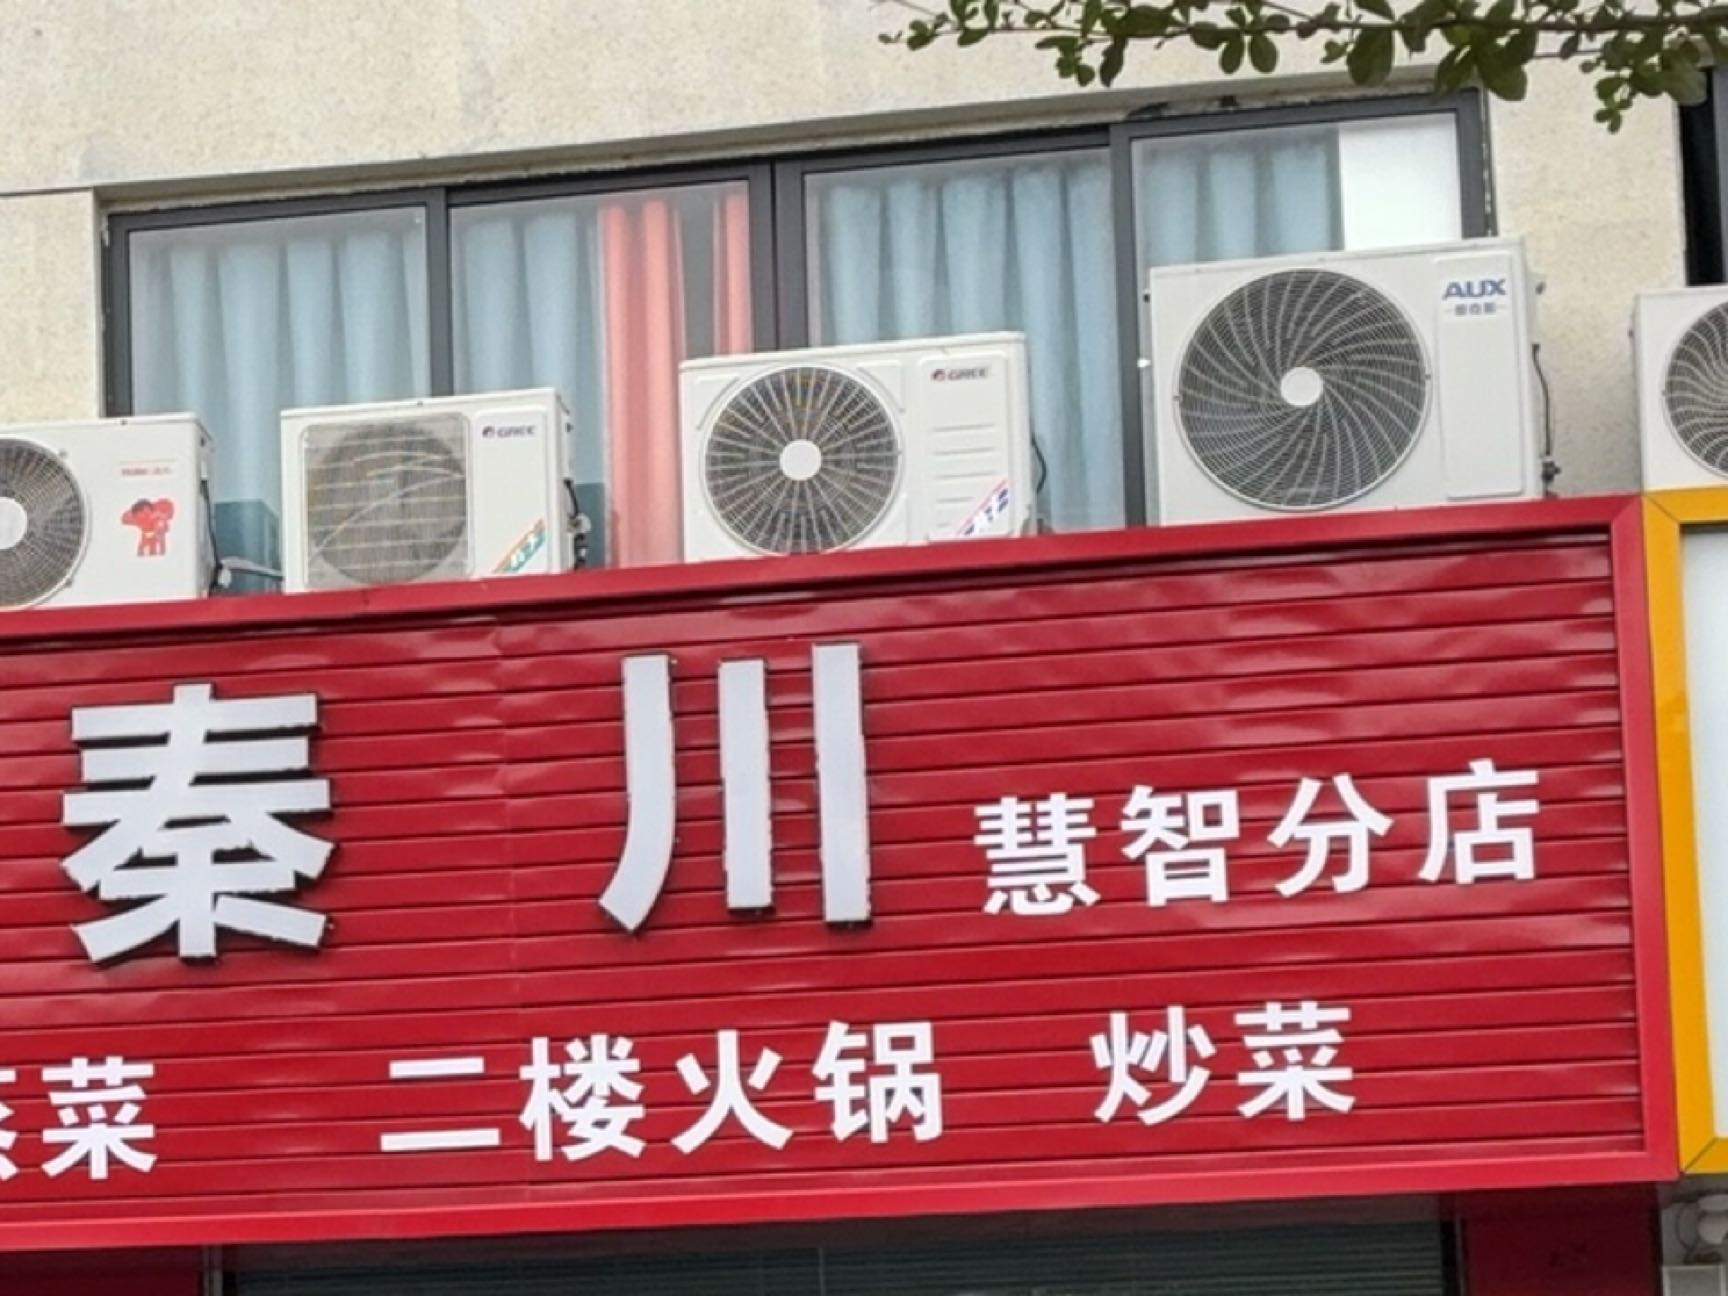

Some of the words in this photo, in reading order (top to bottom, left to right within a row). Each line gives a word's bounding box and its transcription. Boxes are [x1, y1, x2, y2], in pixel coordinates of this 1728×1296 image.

[1441, 278, 1507, 301] AUX
[973, 758, 1541, 917] 慧智分店
[379, 1020, 944, 1163] 二楼火锅
[1089, 1000, 1356, 1127] 炒菜
